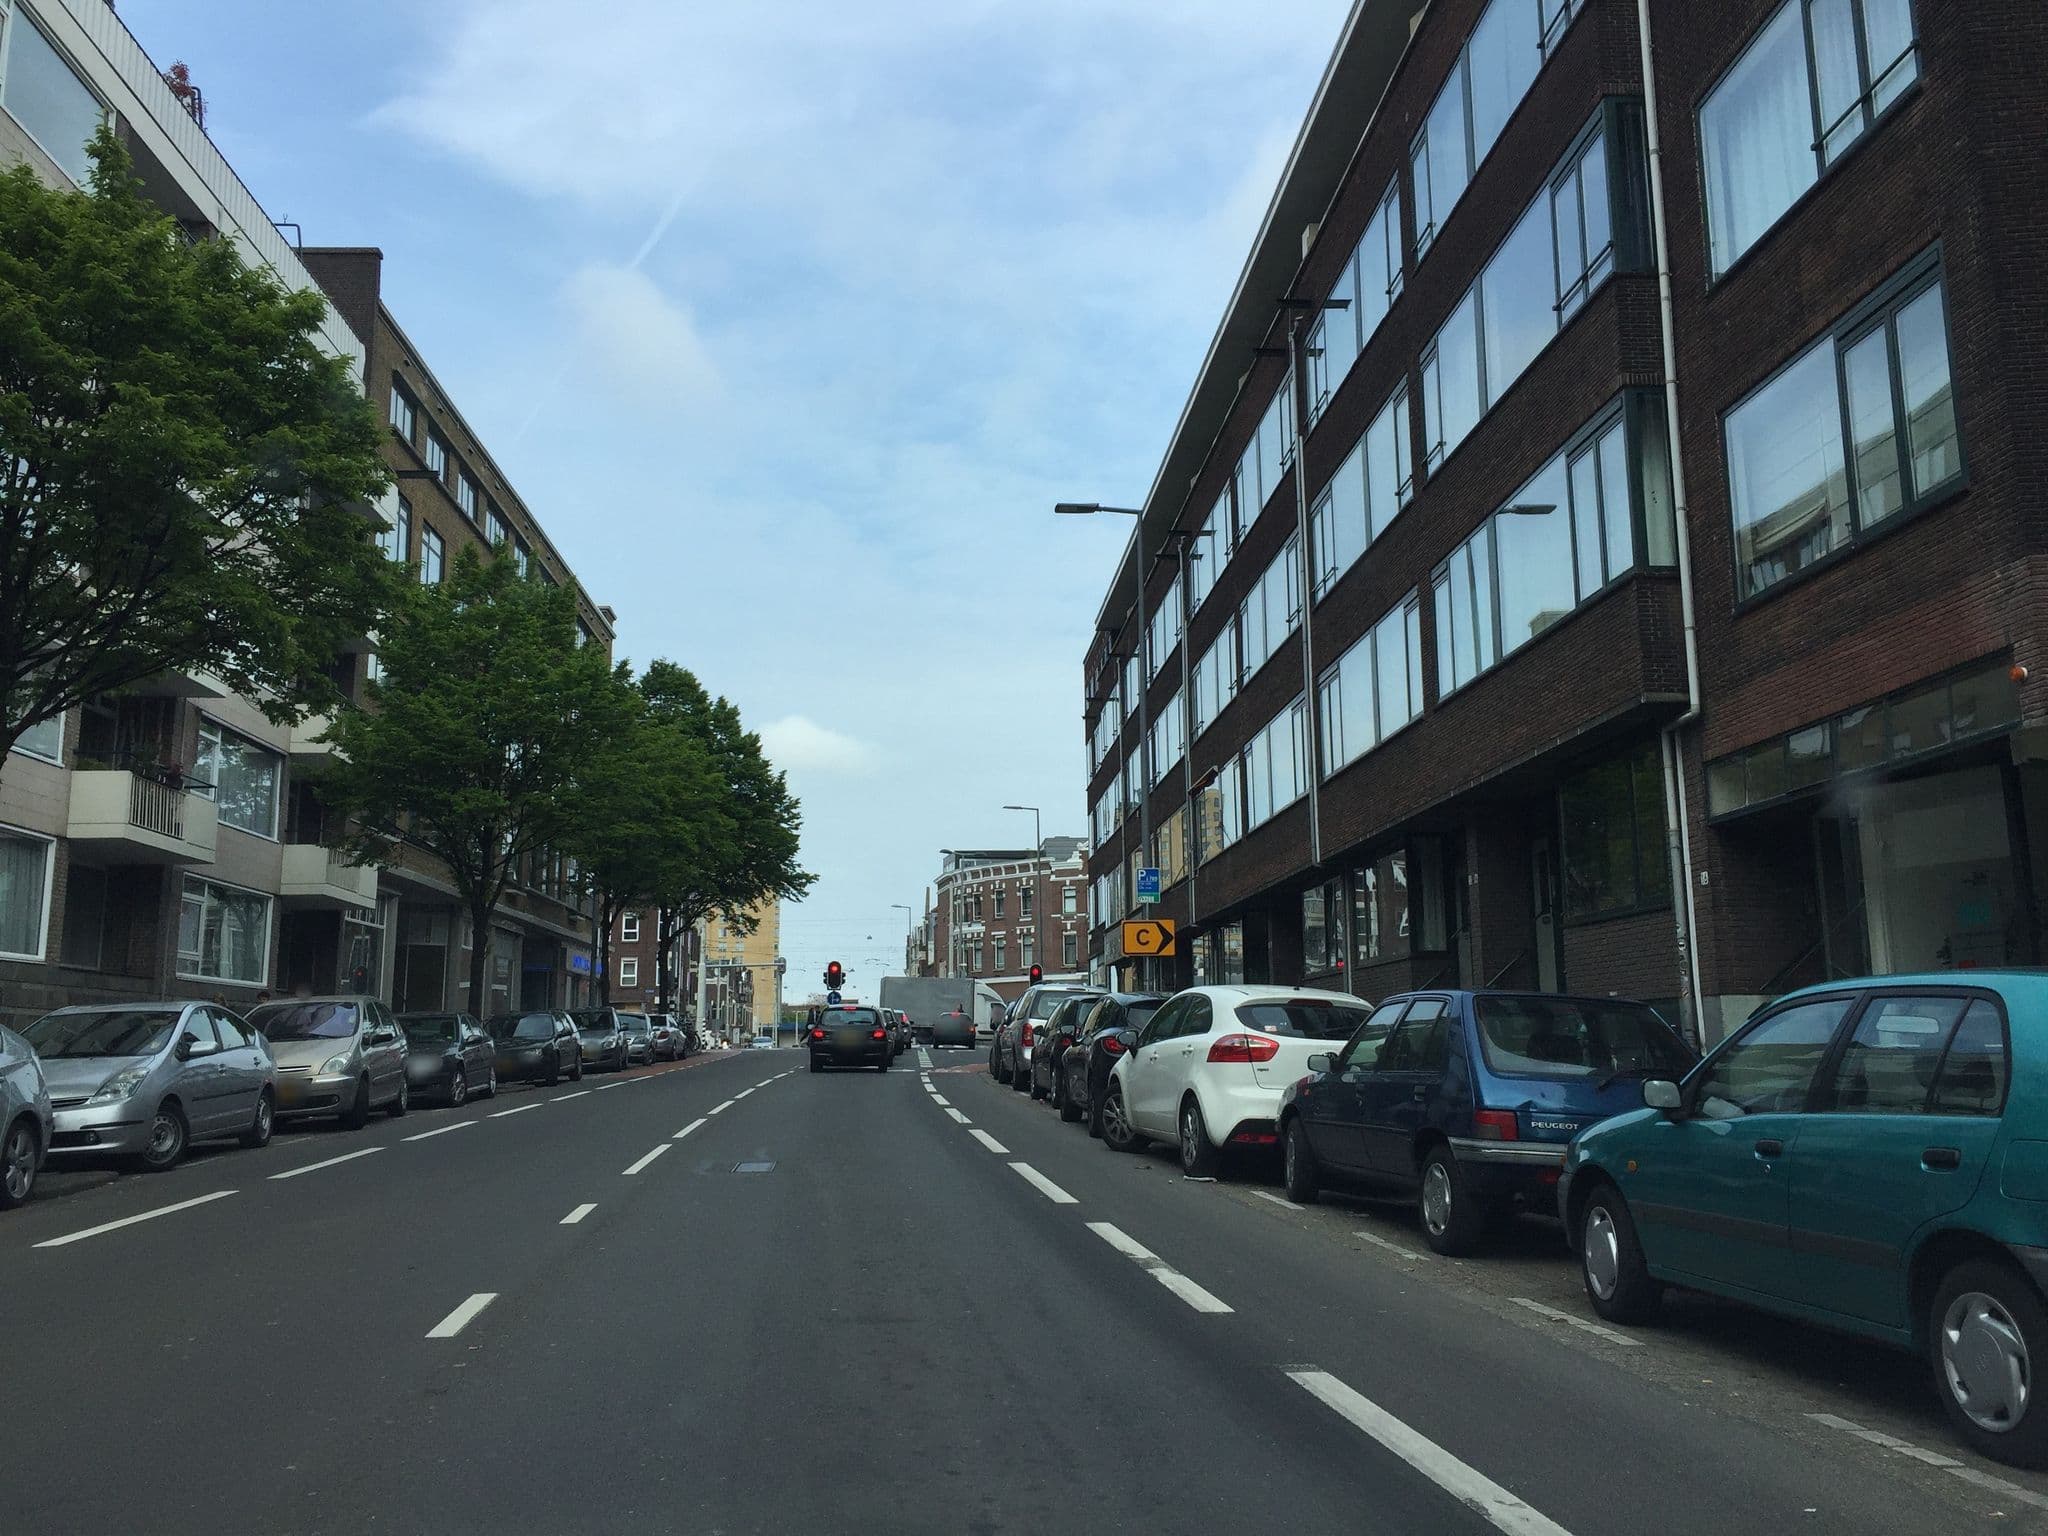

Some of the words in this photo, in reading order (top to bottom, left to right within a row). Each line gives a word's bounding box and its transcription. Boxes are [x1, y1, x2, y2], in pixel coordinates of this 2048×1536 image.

[1138, 869, 1146, 881] P
[1136, 928, 1150, 946] C
[1531, 1121, 1579, 1130] PEUGEOT
